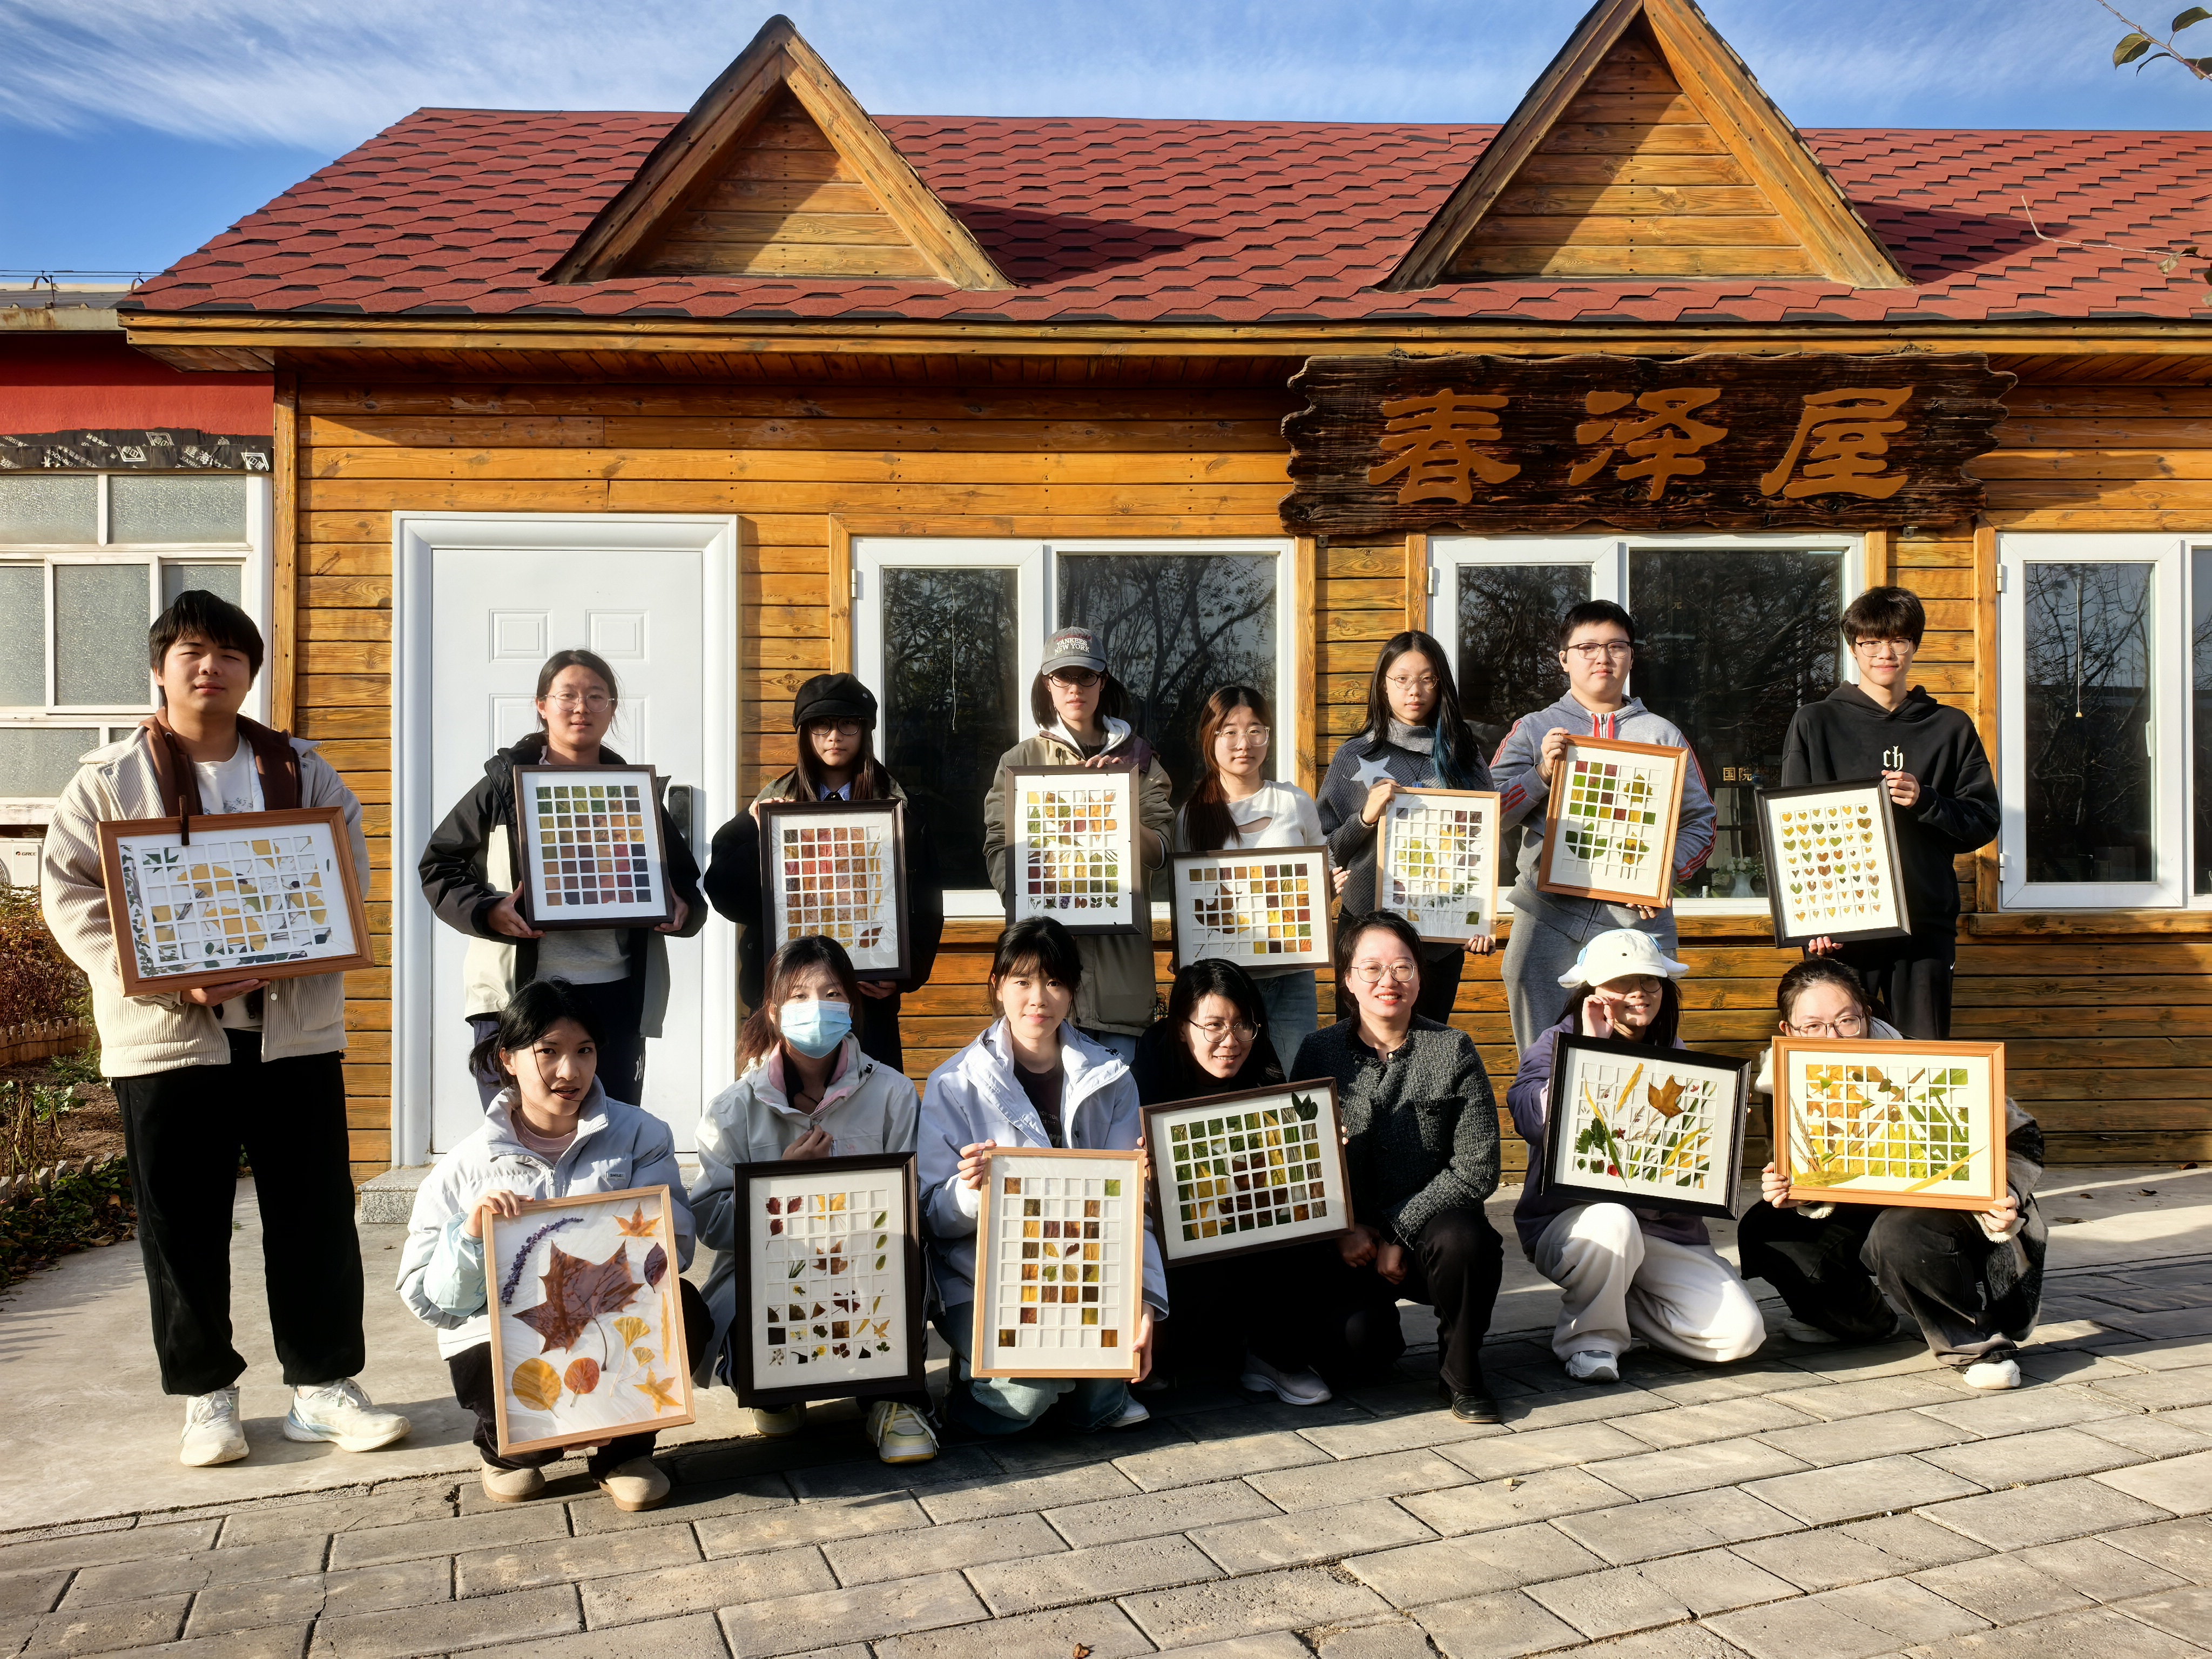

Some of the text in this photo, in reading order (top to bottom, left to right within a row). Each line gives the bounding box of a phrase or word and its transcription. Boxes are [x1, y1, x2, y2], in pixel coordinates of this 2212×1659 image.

[1368, 386, 1913, 505] 春泽屋
[1055, 643, 1090, 656] NEW YORK
